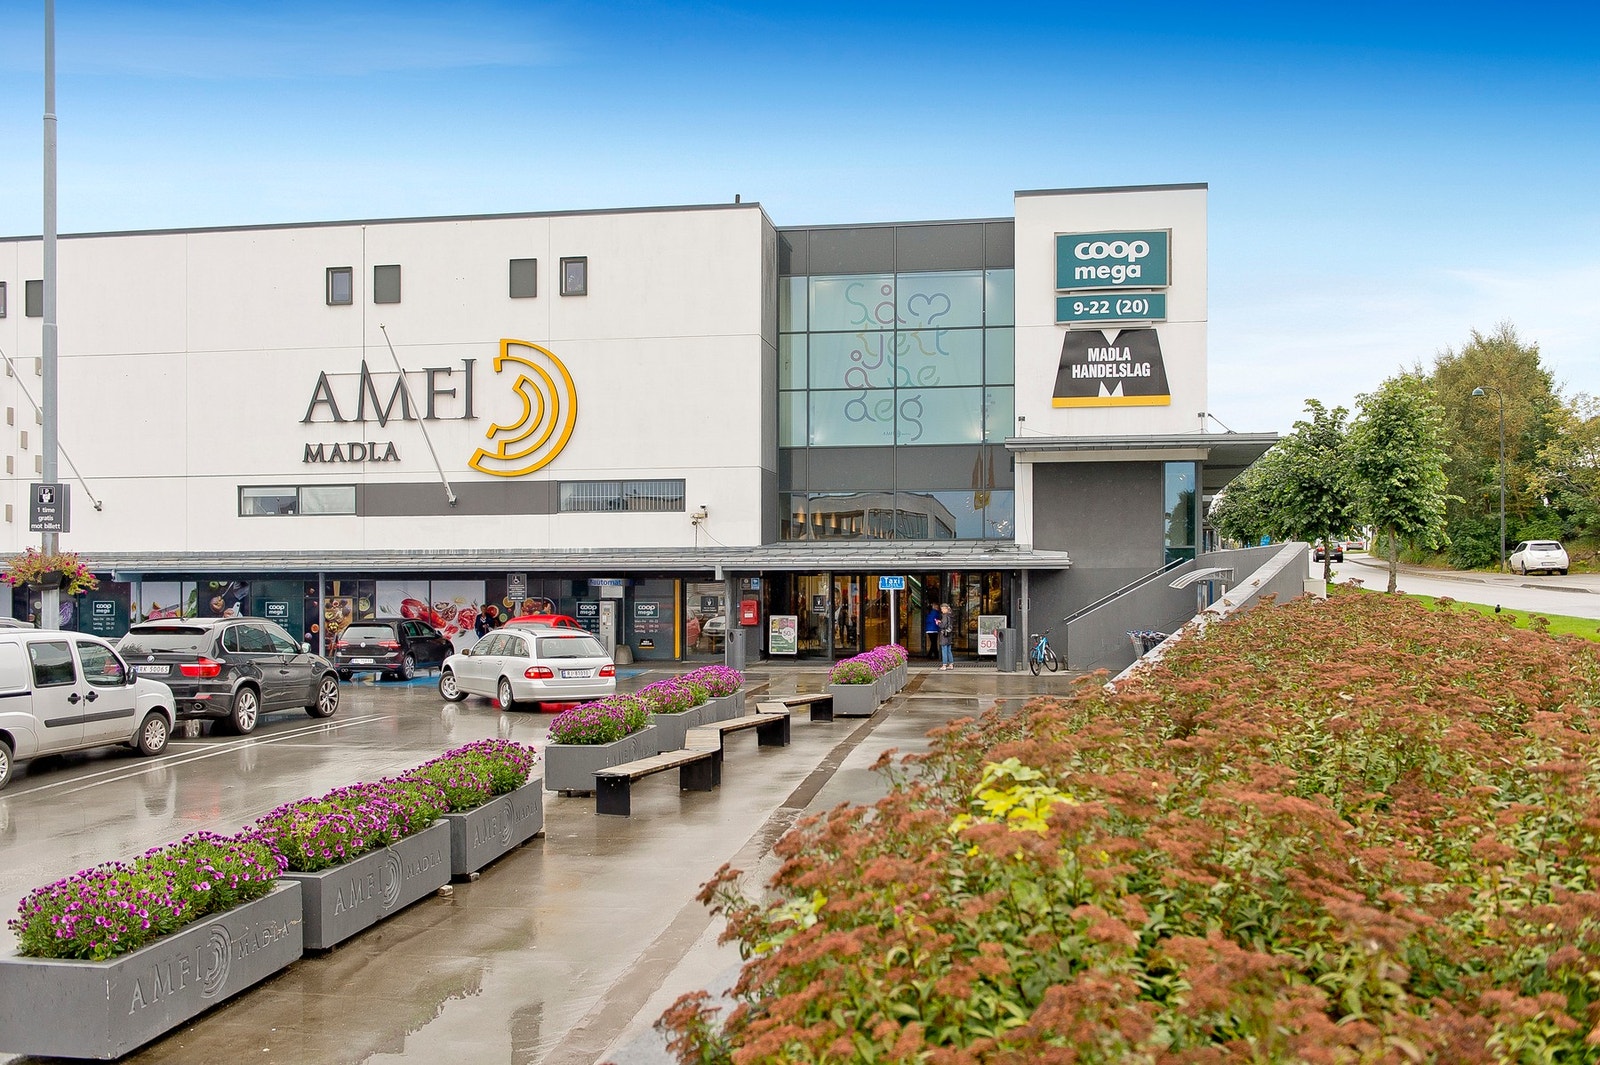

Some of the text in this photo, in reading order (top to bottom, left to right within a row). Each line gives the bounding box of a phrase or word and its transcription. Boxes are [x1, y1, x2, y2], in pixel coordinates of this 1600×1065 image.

[1074, 240, 1150, 263] coop
[1074, 264, 1141, 284] mega
[1073, 299, 1149, 316] 9-22 (20)
[1087, 347, 1131, 362] MADLA
[1072, 362, 1151, 379] HANDELSLAG
[299, 358, 479, 428] AMFI
[302, 441, 401, 463] MADLA
[334, 849, 442, 916] AMFI MADLA
[128, 919, 290, 1015] AMFI MADLA
